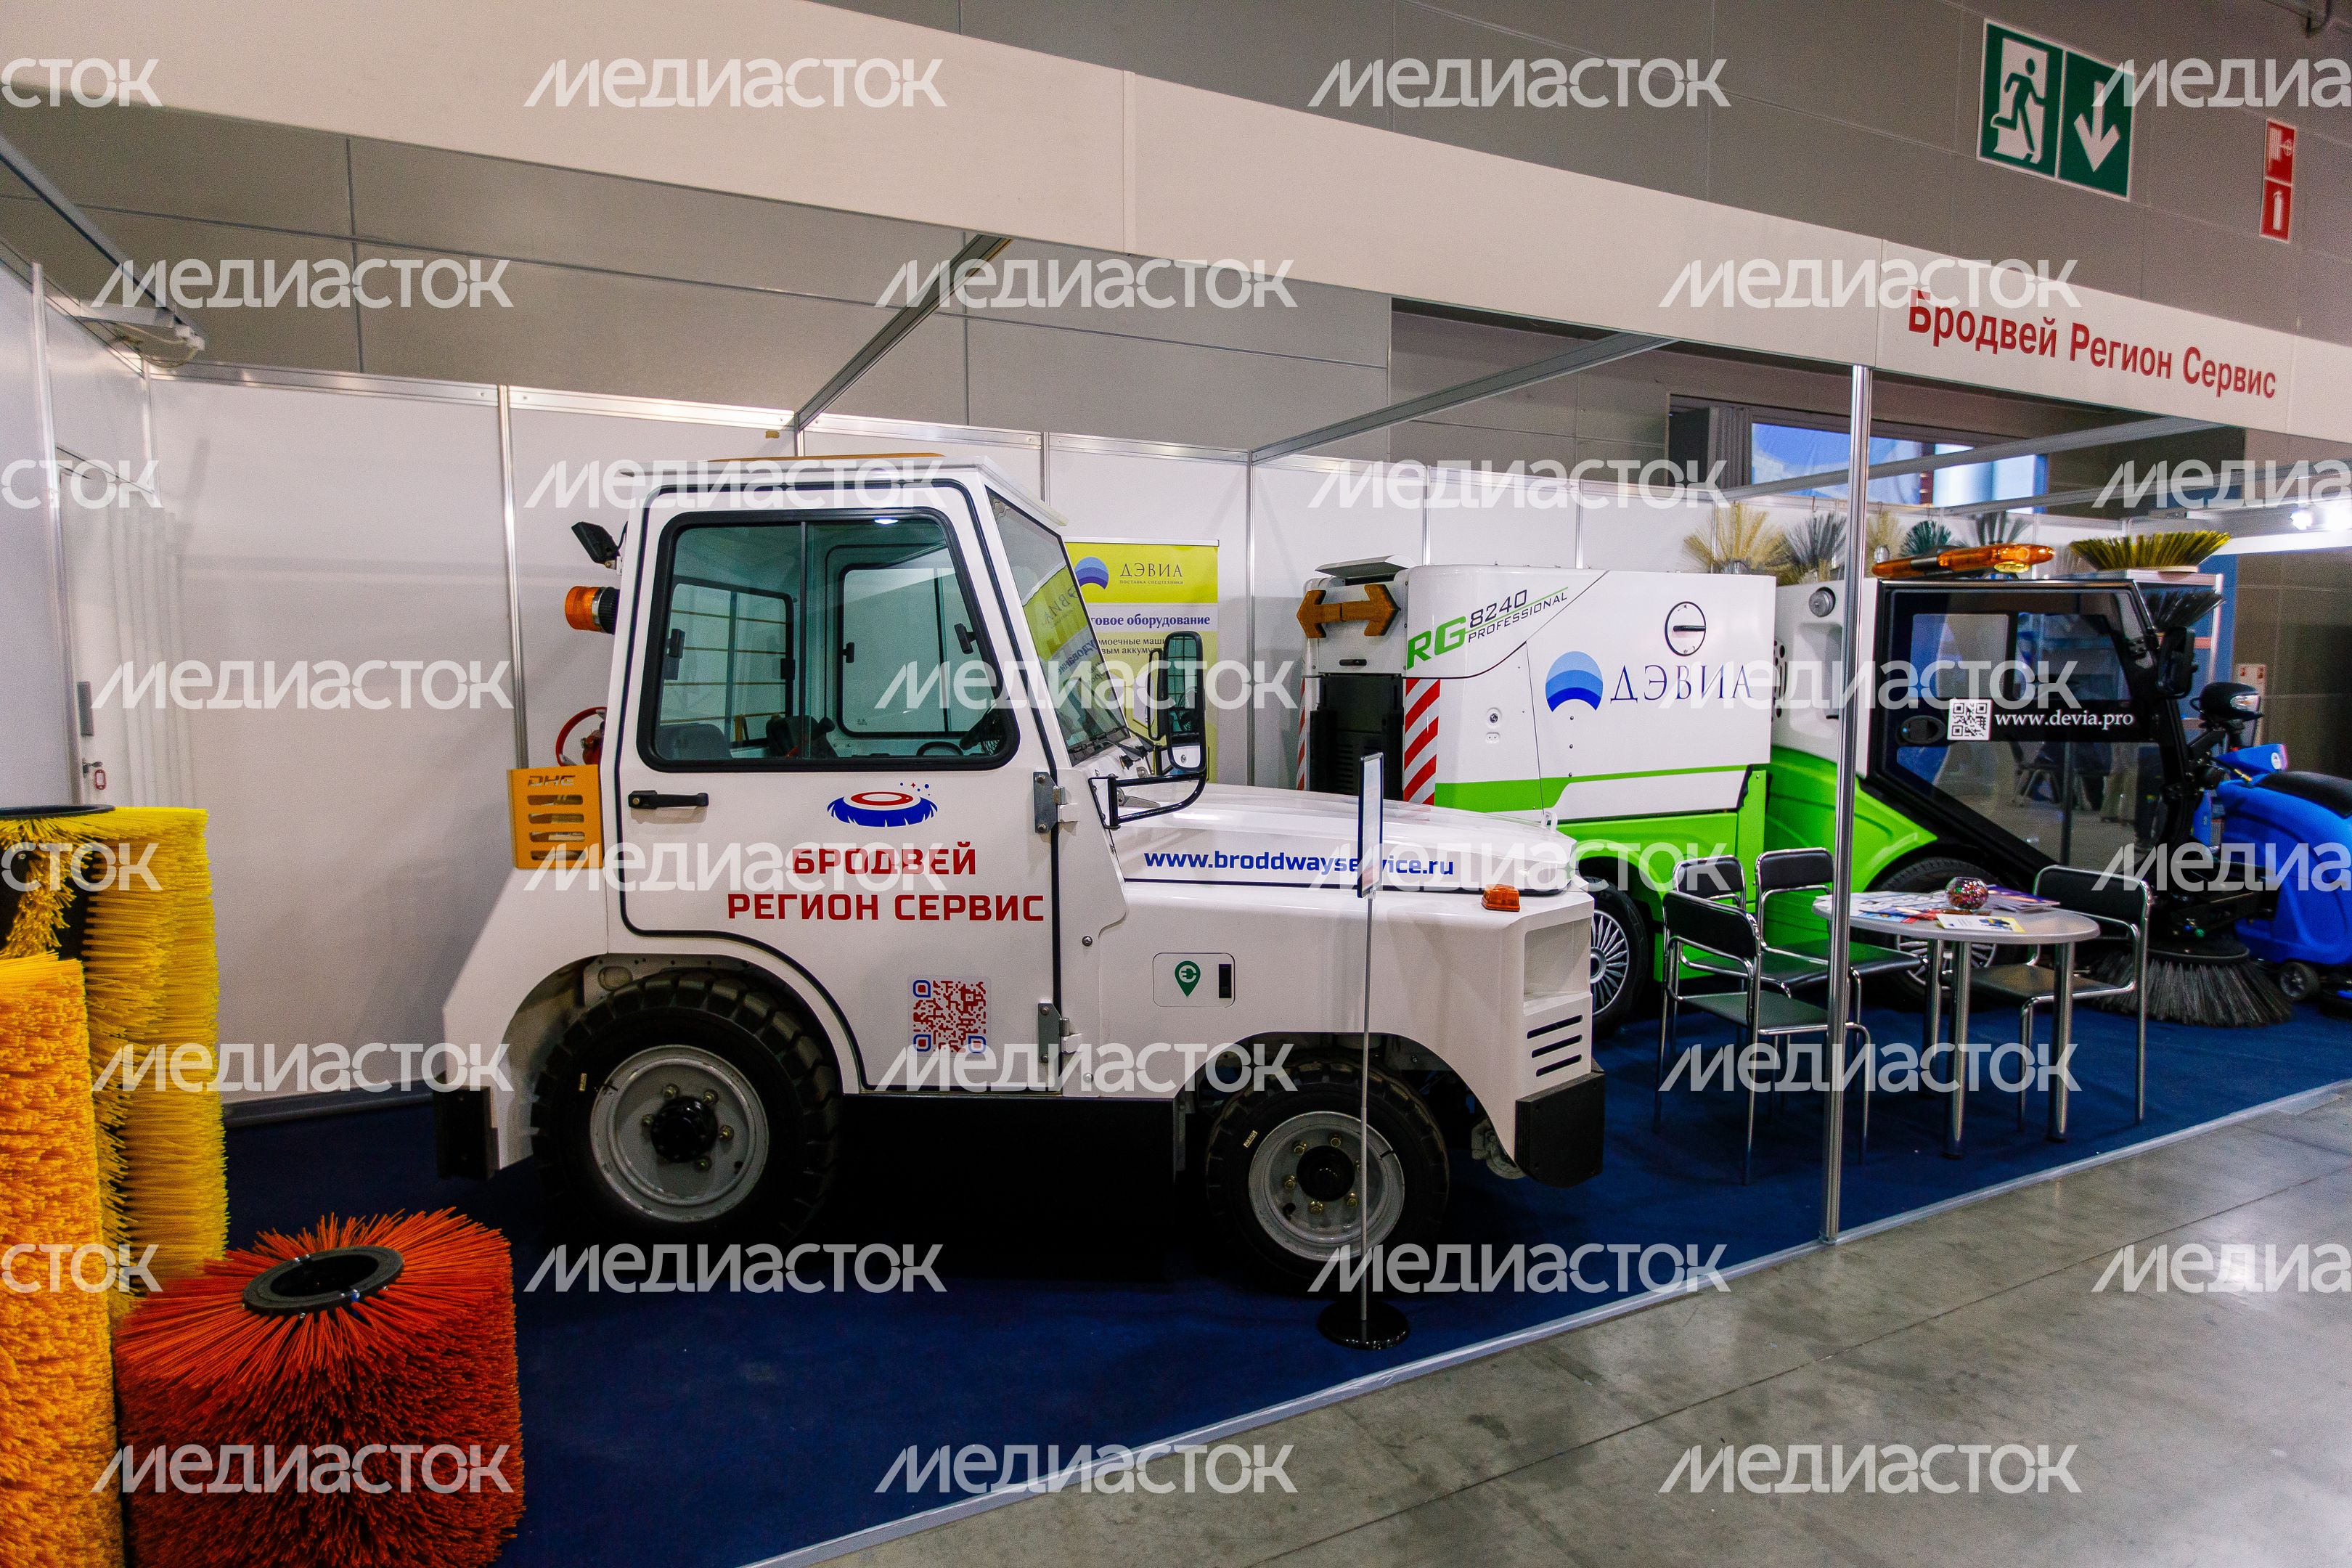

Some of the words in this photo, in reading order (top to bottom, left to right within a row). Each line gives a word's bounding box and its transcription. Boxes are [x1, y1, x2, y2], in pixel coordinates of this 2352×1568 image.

[1908, 289, 2057, 359] Бродвей
[2070, 322, 2173, 380] Регион
[2182, 346, 2277, 399] Сервис
[1119, 563, 1183, 578] ДЭВИА
[1127, 613, 1211, 629] оборудование
[1407, 616, 1466, 670] RG
[1469, 589, 1527, 629] 8240
[1468, 592, 1568, 643] PROFESSIONAL
[1610, 664, 1753, 704] ДЭВИА
[1995, 709, 2133, 731] www.devia.pro
[792, 841, 976, 875] БРОДВЕЙ
[1145, 850, 1454, 875] www.broddwayseice.ru
[728, 894, 878, 921] РЕГИОН
[894, 894, 1044, 921] СЕРВИС
